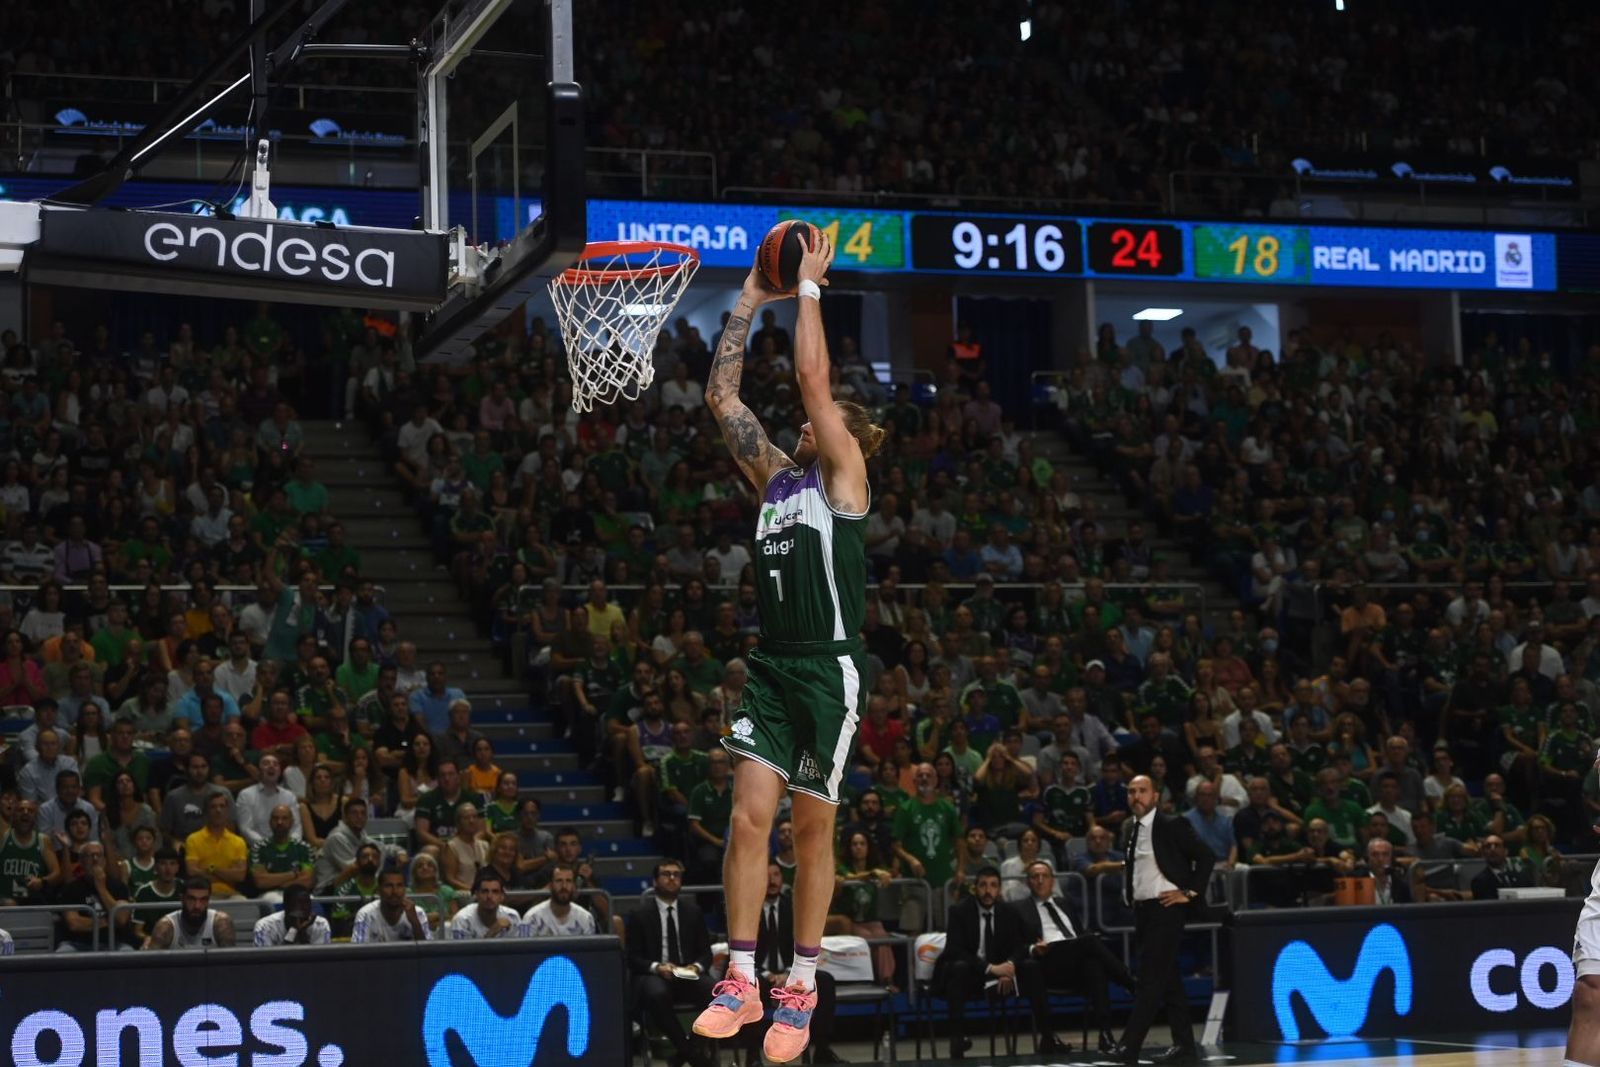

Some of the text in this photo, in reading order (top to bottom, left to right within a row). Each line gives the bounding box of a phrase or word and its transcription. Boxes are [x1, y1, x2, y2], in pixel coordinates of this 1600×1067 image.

[143, 222, 395, 288] endesa
[617, 222, 748, 250] UNICAJA
[951, 221, 1066, 272] 9:16
[1110, 229, 1163, 269] 24
[1227, 234, 1281, 277] 18
[1312, 245, 1487, 274] REAL MADRID
[769, 569, 784, 602] 1
[10, 1000, 345, 1067] ones.
